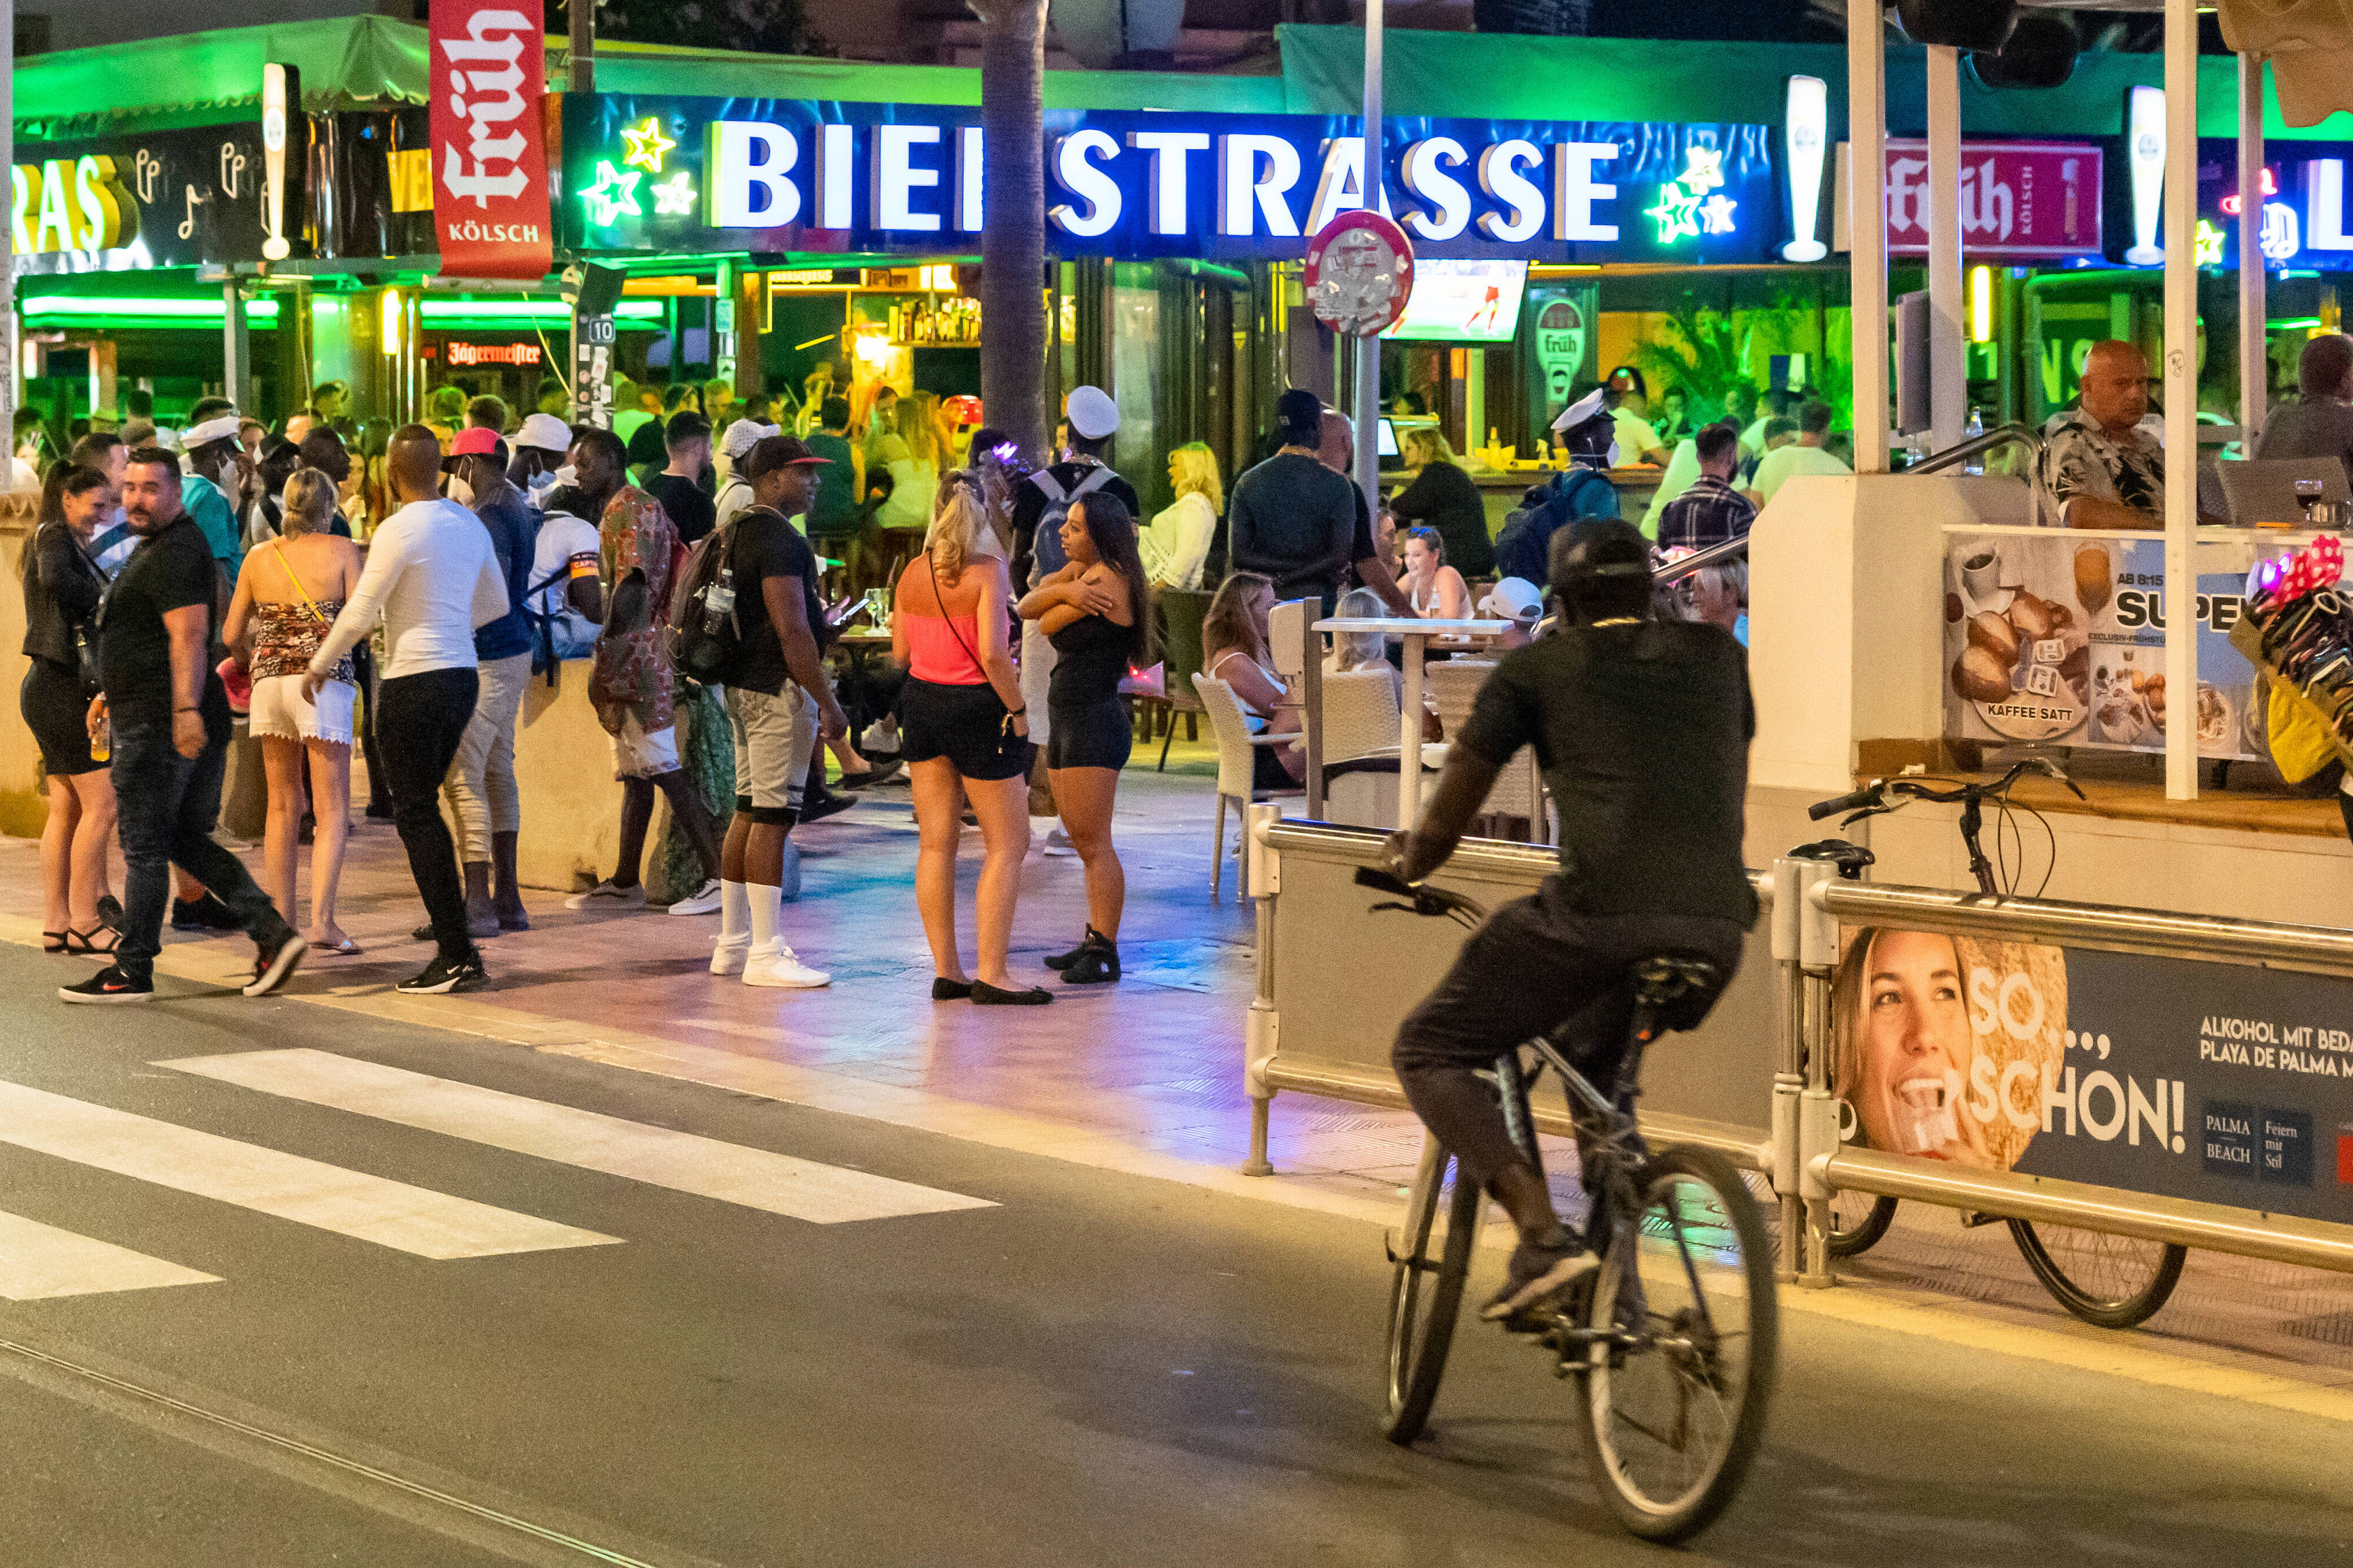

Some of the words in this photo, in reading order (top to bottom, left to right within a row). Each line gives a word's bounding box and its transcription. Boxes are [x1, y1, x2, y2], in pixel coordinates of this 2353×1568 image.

[439, 9, 535, 209] früh
[449, 220, 539, 242] KÖLSCH
[594, 322, 613, 340] 10
[2118, 573, 2135, 585] AB
[2137, 573, 2165, 587] 8:15
[1987, 703, 2037, 719] KAFFEE
[2039, 706, 2074, 722] SATT
[2200, 1016, 2279, 1045] ALKOHOL
[2283, 1026, 2314, 1047] MIT
[2200, 1039, 2250, 1066] PLAYA
[2254, 1045, 2275, 1069] DE
[2279, 1049, 2338, 1077] PALMA
[2207, 1115, 2251, 1136] PALMA
[2265, 1119, 2297, 1139] Feiern
[2207, 1143, 2251, 1164] BEACH
[2265, 1137, 2283, 1151] mit
[2265, 1152, 2282, 1169] Stil
